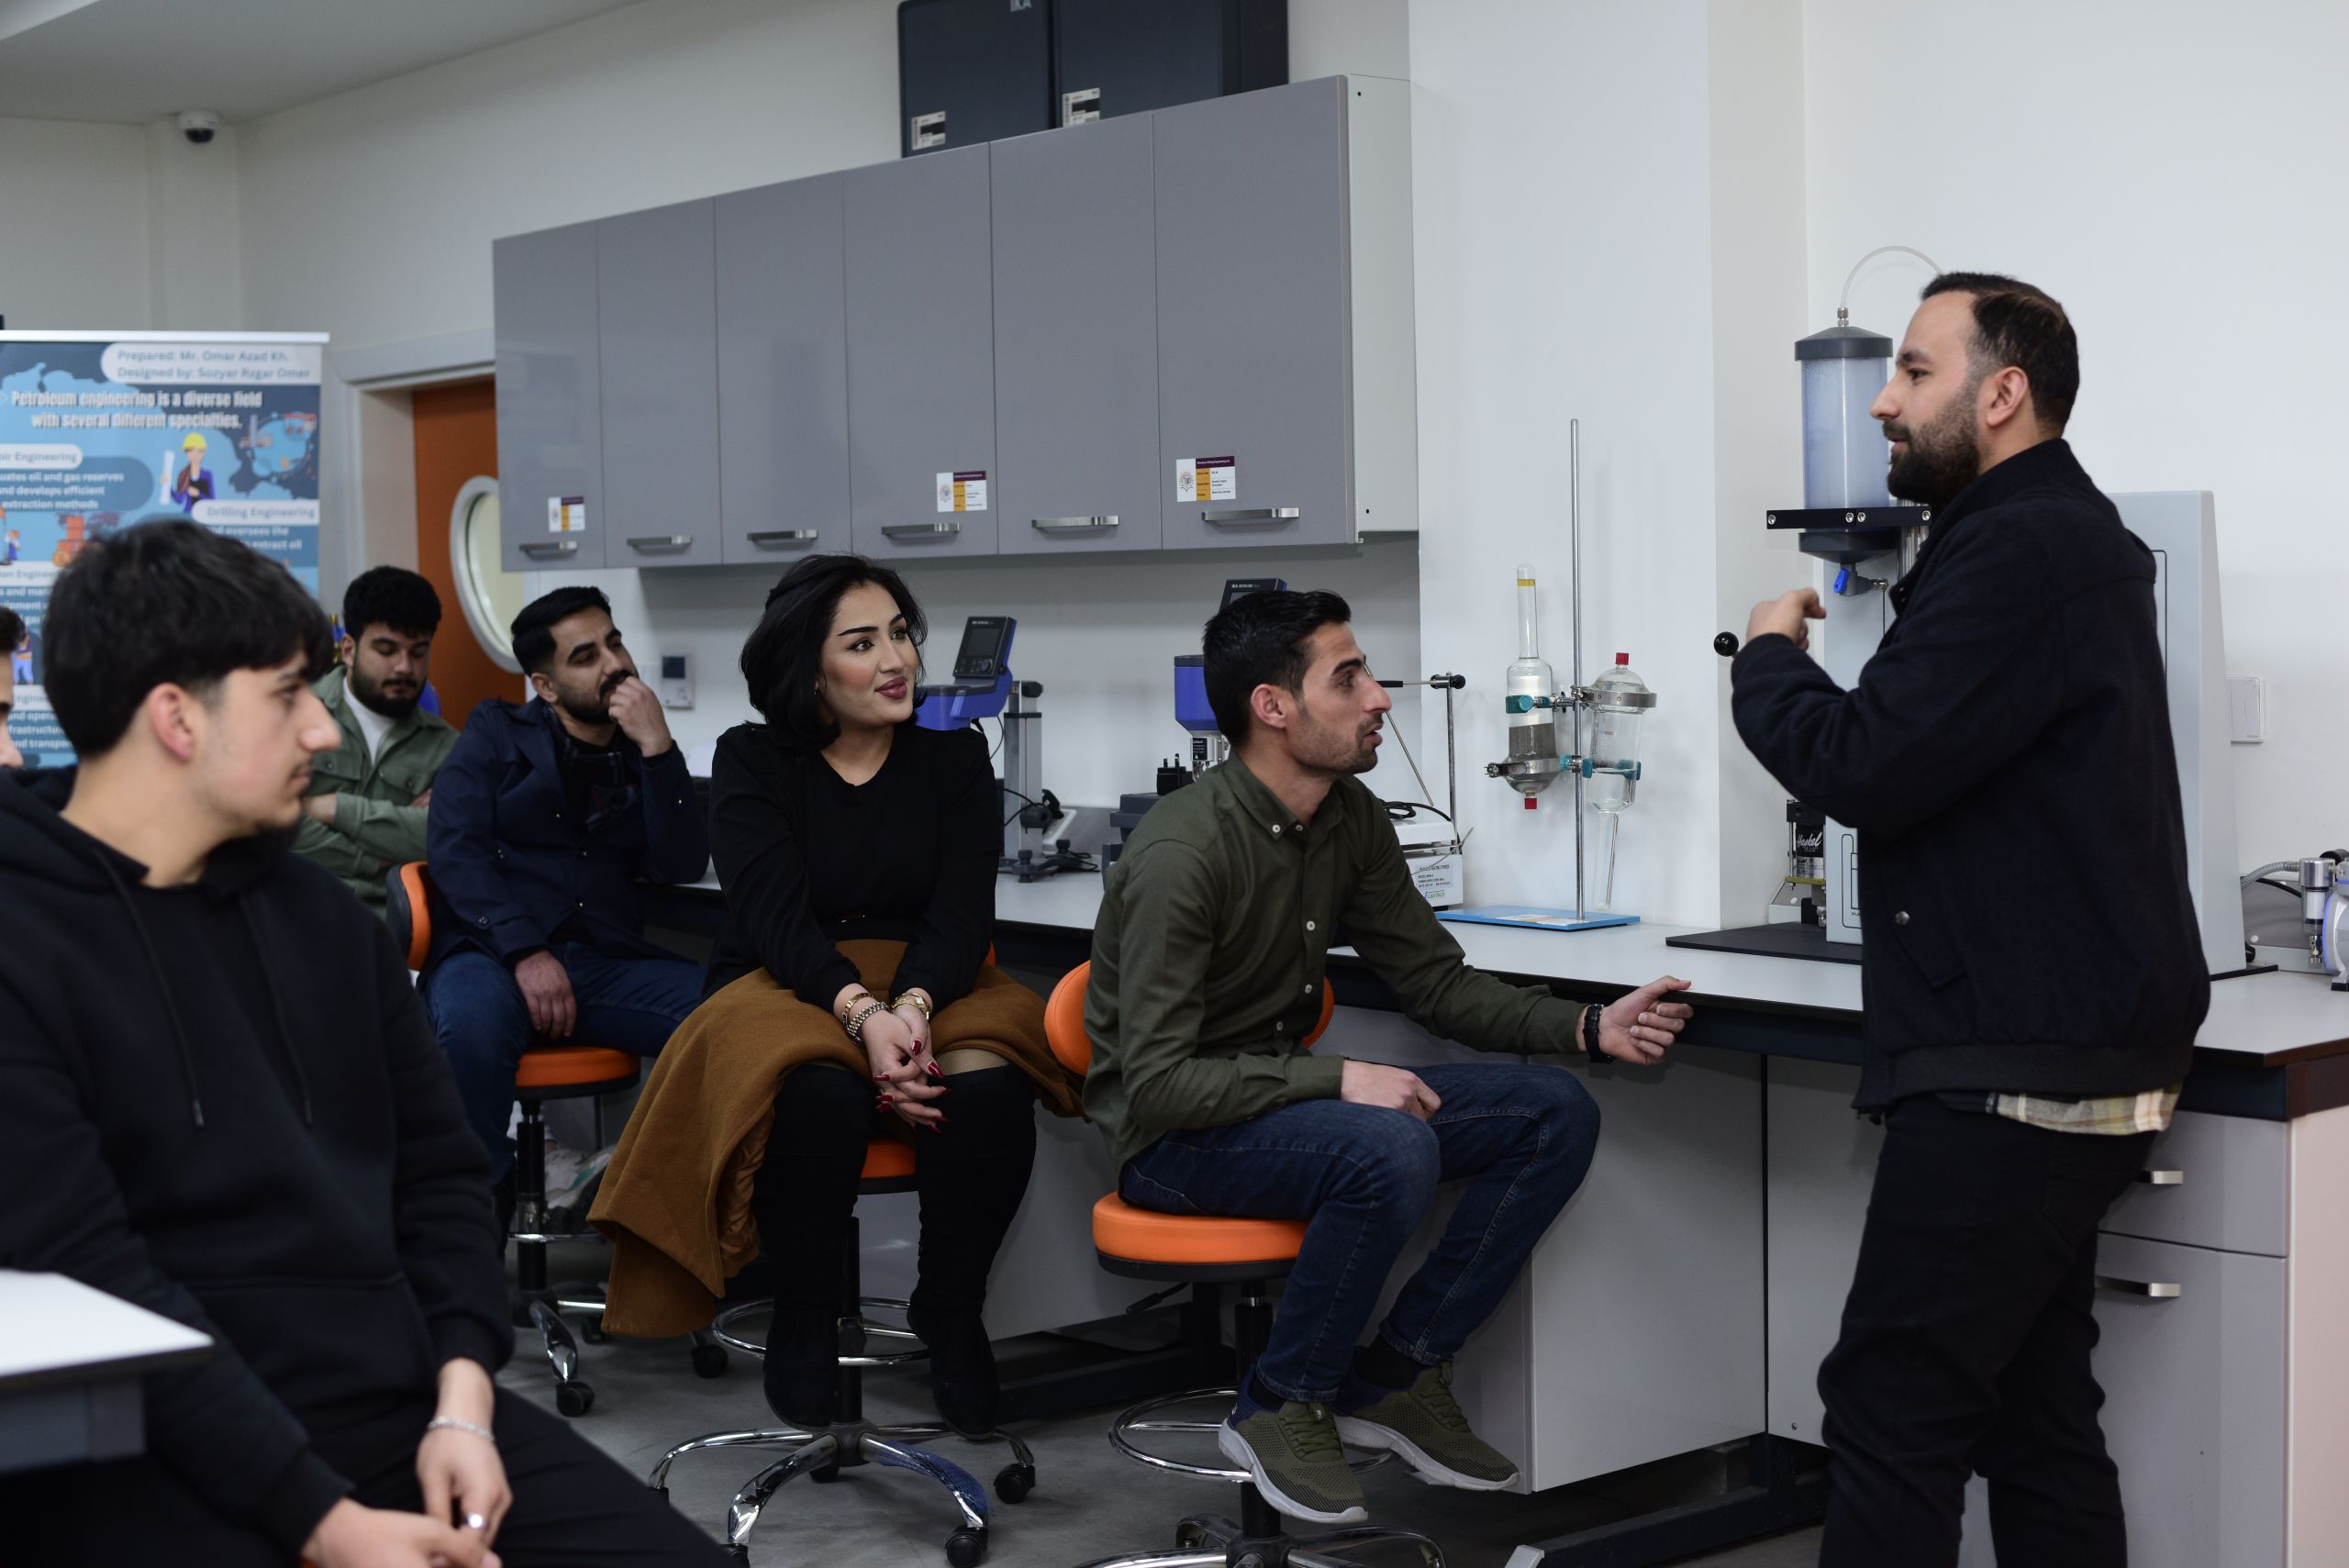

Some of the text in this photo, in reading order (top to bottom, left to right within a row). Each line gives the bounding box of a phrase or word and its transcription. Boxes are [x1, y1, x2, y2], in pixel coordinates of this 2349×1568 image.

[117, 350, 175, 363] Prepared:
[181, 350, 197, 361] Mr.
[239, 350, 268, 361] Azad
[117, 367, 173, 380] Designed
[12, 391, 262, 409] Petroleum engineering is a diverse field
[31, 412, 242, 429] with several different specialties.
[15, 451, 76, 463] Engineering
[0, 472, 125, 484] uates oil and gas reserves
[0, 485, 106, 498] nd develops efficient
[2, 499, 99, 510] extraction methods
[207, 506, 315, 519] Drilling Engineering
[271, 526, 289, 536] the
[252, 539, 288, 550] extract
[289, 539, 303, 550] oil
[6, 587, 26, 596] and
